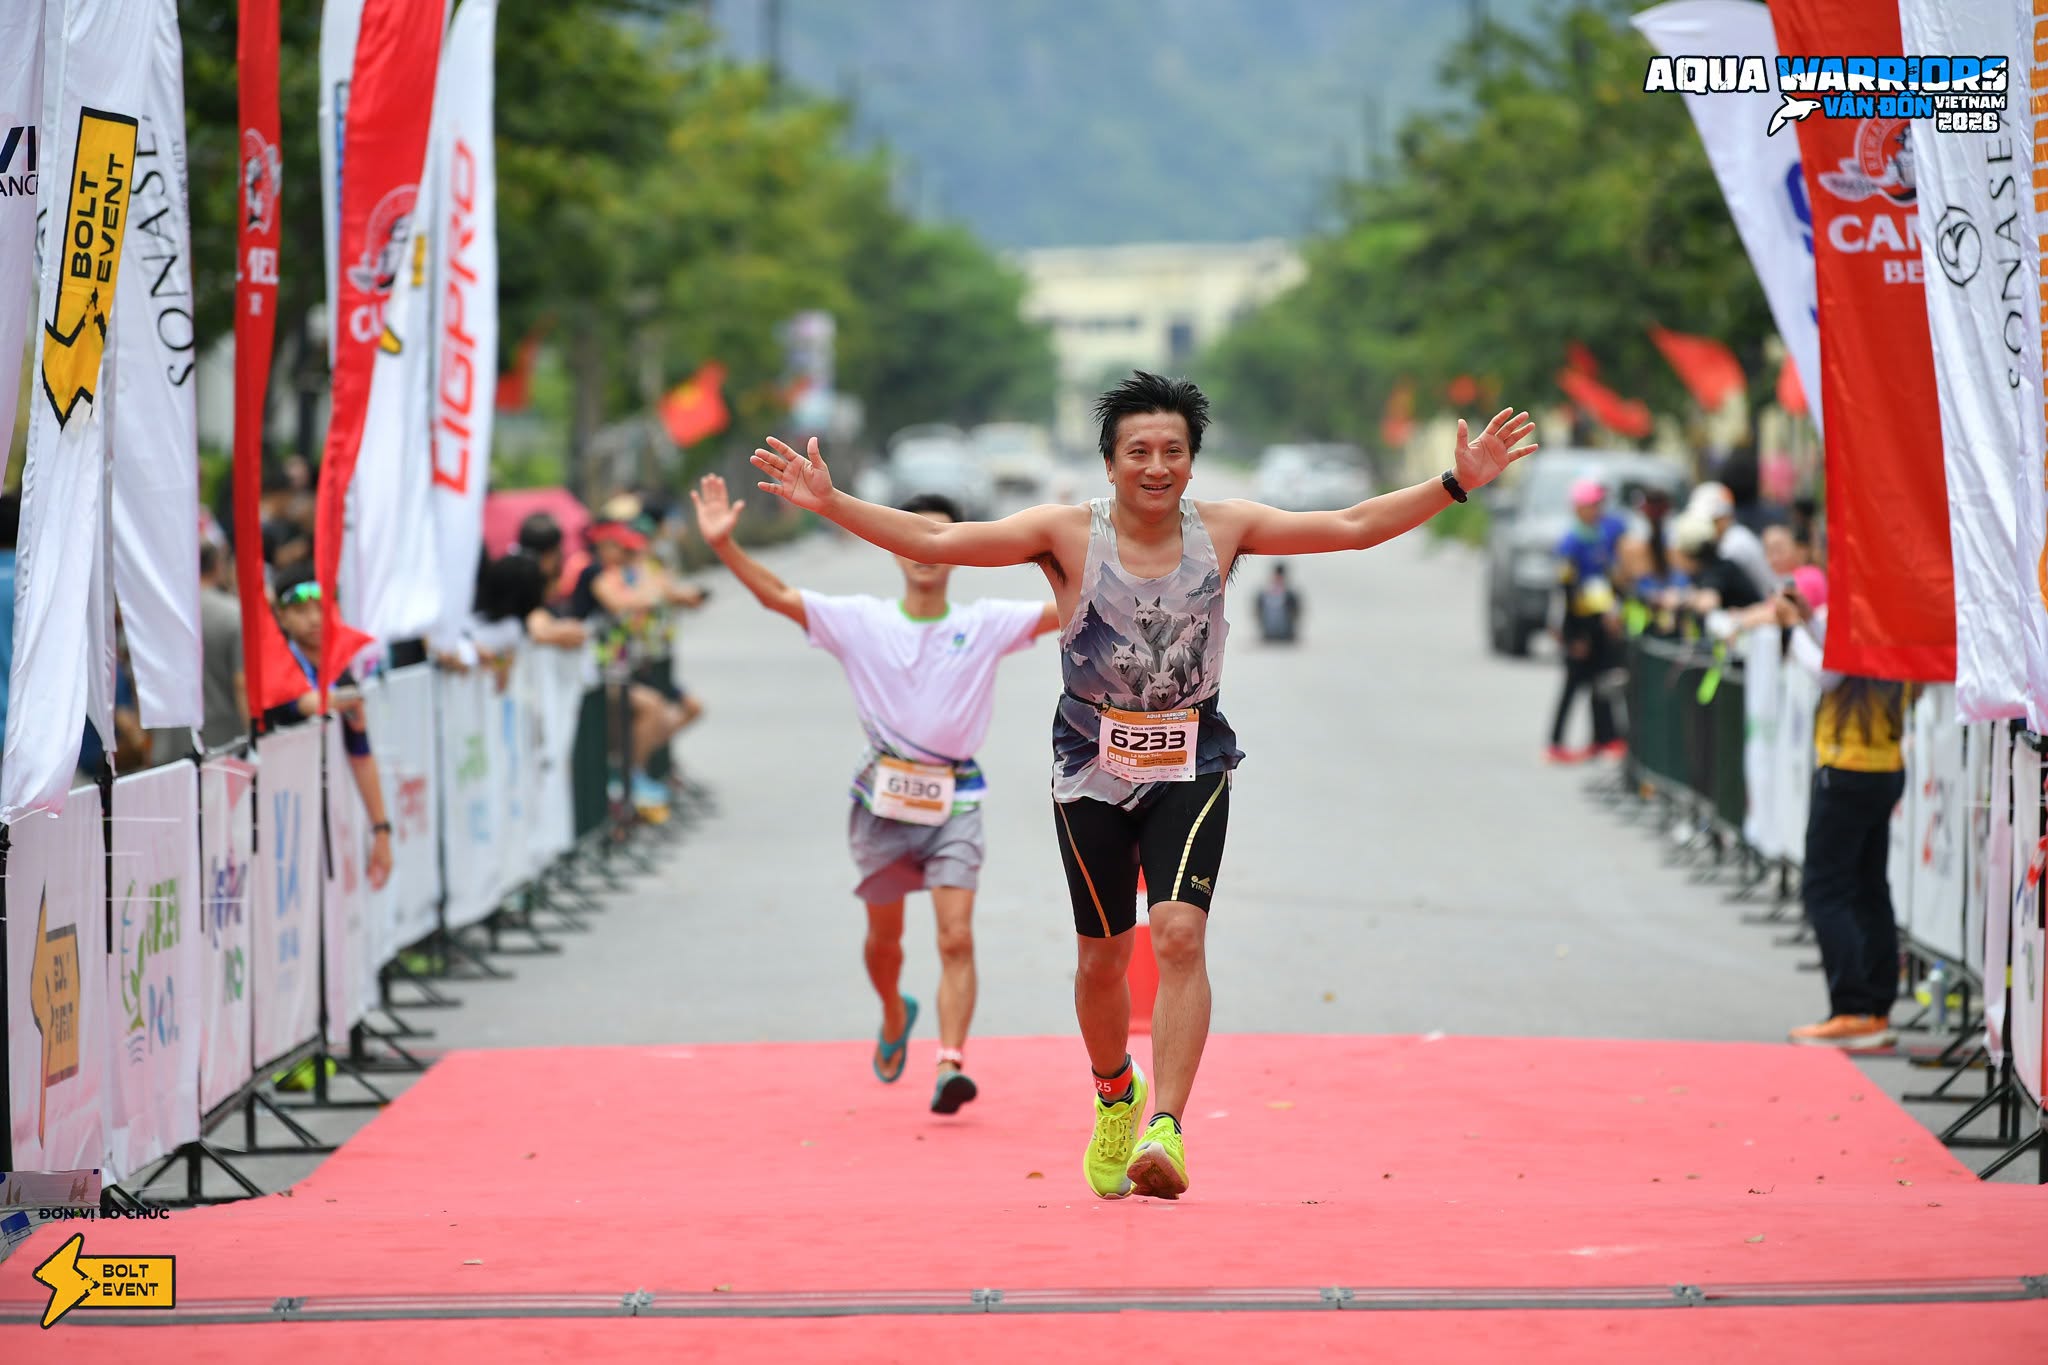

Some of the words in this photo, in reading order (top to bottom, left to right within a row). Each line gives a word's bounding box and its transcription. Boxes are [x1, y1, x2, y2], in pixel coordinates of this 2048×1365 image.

[71, 170, 98, 279] BOLT
[97, 153, 124, 283] EVENT
[1986, 116, 2022, 390] SONASE
[888, 777, 941, 799] 6130
[1110, 728, 1186, 751] 6233
